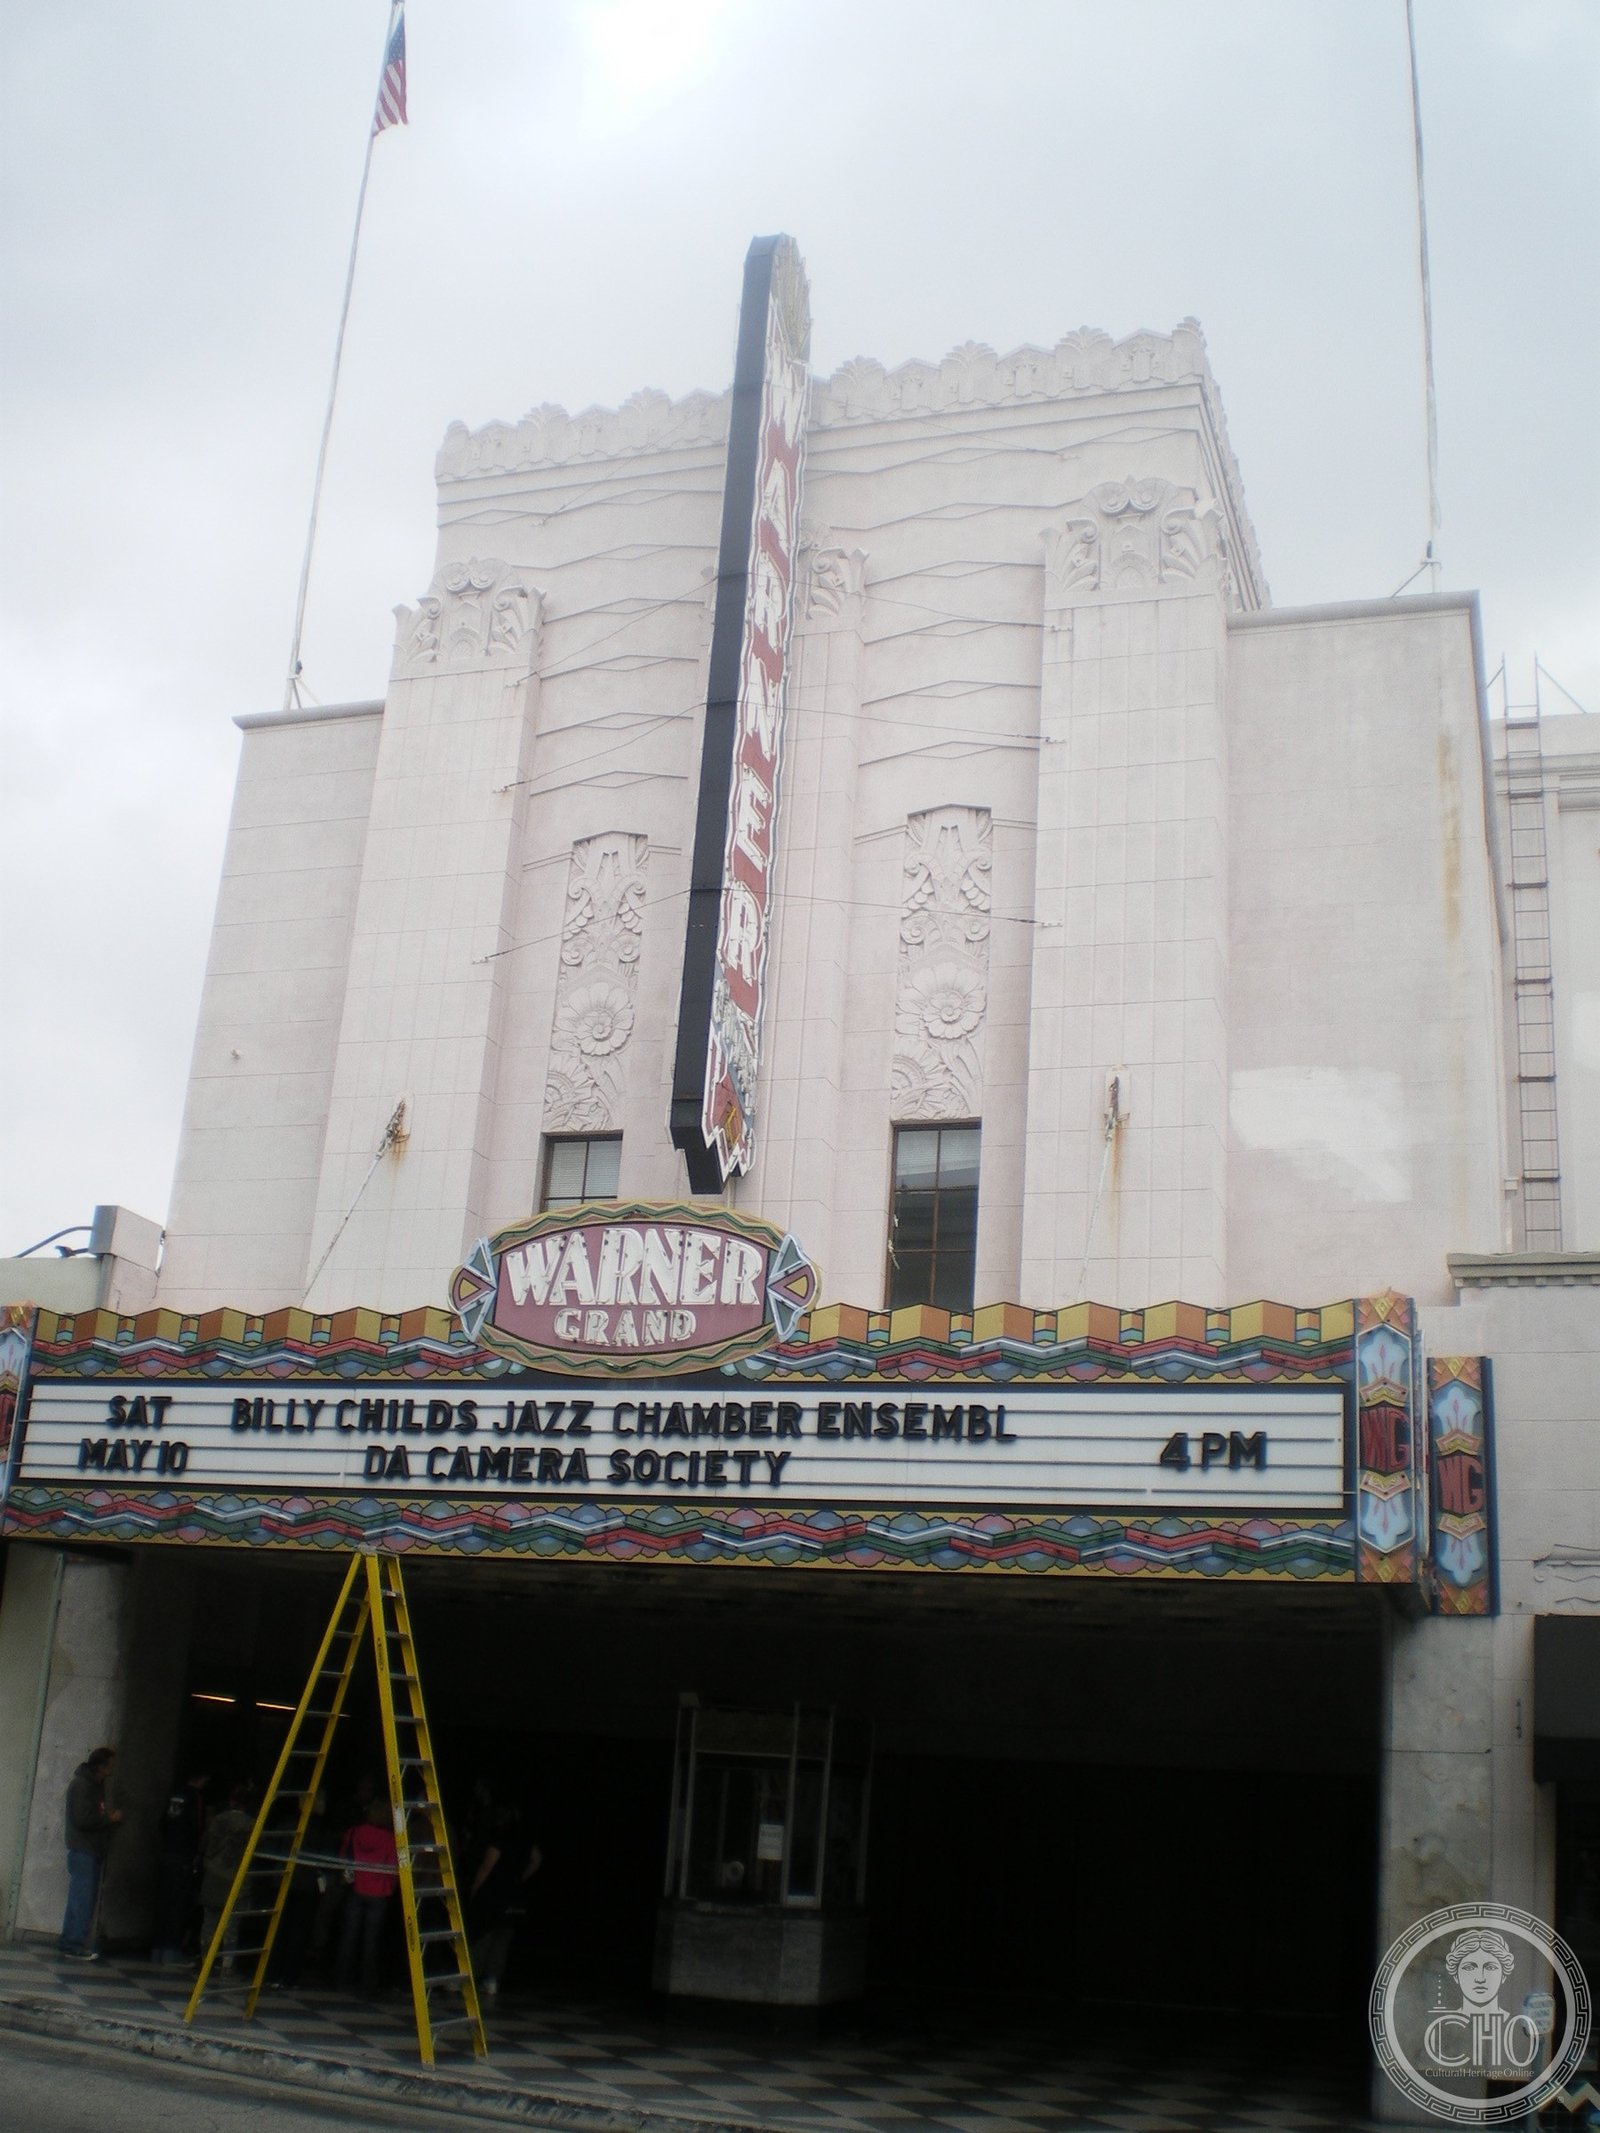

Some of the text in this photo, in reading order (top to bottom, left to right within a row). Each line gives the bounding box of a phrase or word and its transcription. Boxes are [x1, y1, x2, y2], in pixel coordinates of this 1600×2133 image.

[722, 342, 806, 989] WARNER
[506, 1228, 764, 1306] WARNER
[554, 1308, 697, 1347] GRAND
[106, 1395, 1017, 1442] SAT BILLY CHILDS JAZZ CHAMBER ENSEMBL
[1360, 1406, 1410, 1473] WG
[78, 1438, 189, 1474] MAY 10
[364, 1445, 791, 1487] DA CAMERA SOCIETY
[1160, 1431, 1267, 1471] 4 PM
[1438, 1455, 1485, 1515] WG
